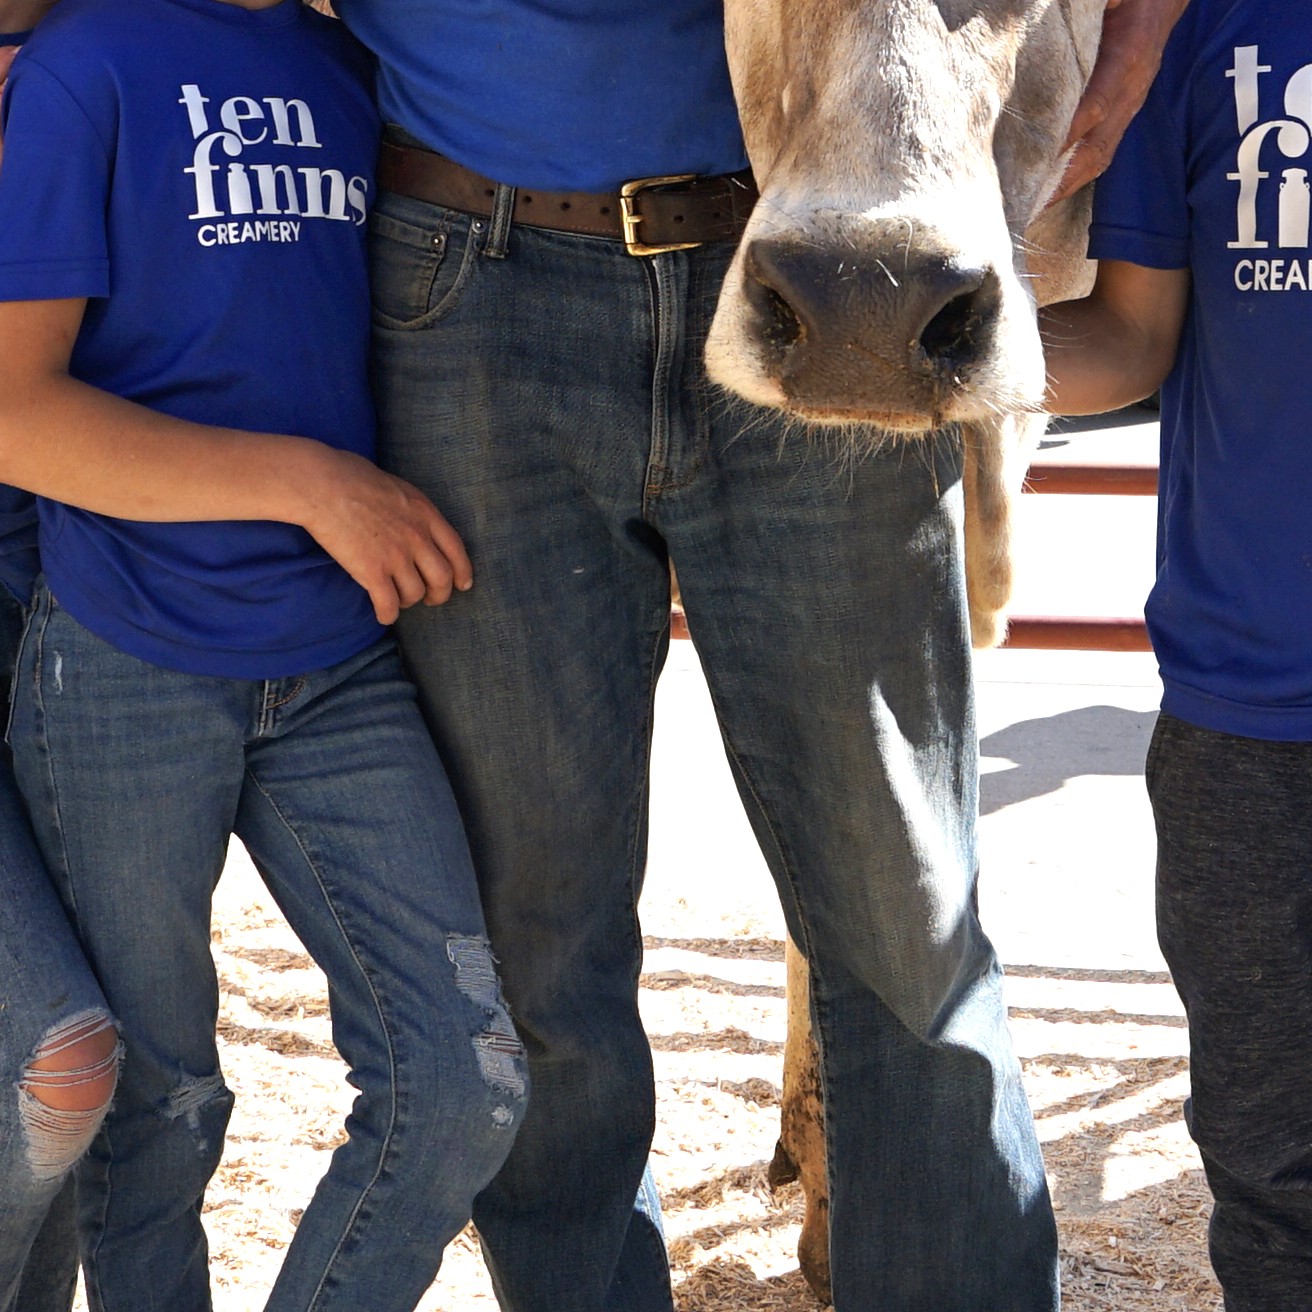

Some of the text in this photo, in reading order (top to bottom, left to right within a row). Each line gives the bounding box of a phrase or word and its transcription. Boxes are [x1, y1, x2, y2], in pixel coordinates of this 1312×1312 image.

[178, 84, 323, 148] ten
[183, 131, 368, 226] finns
[197, 220, 301, 247] CREAMERY
